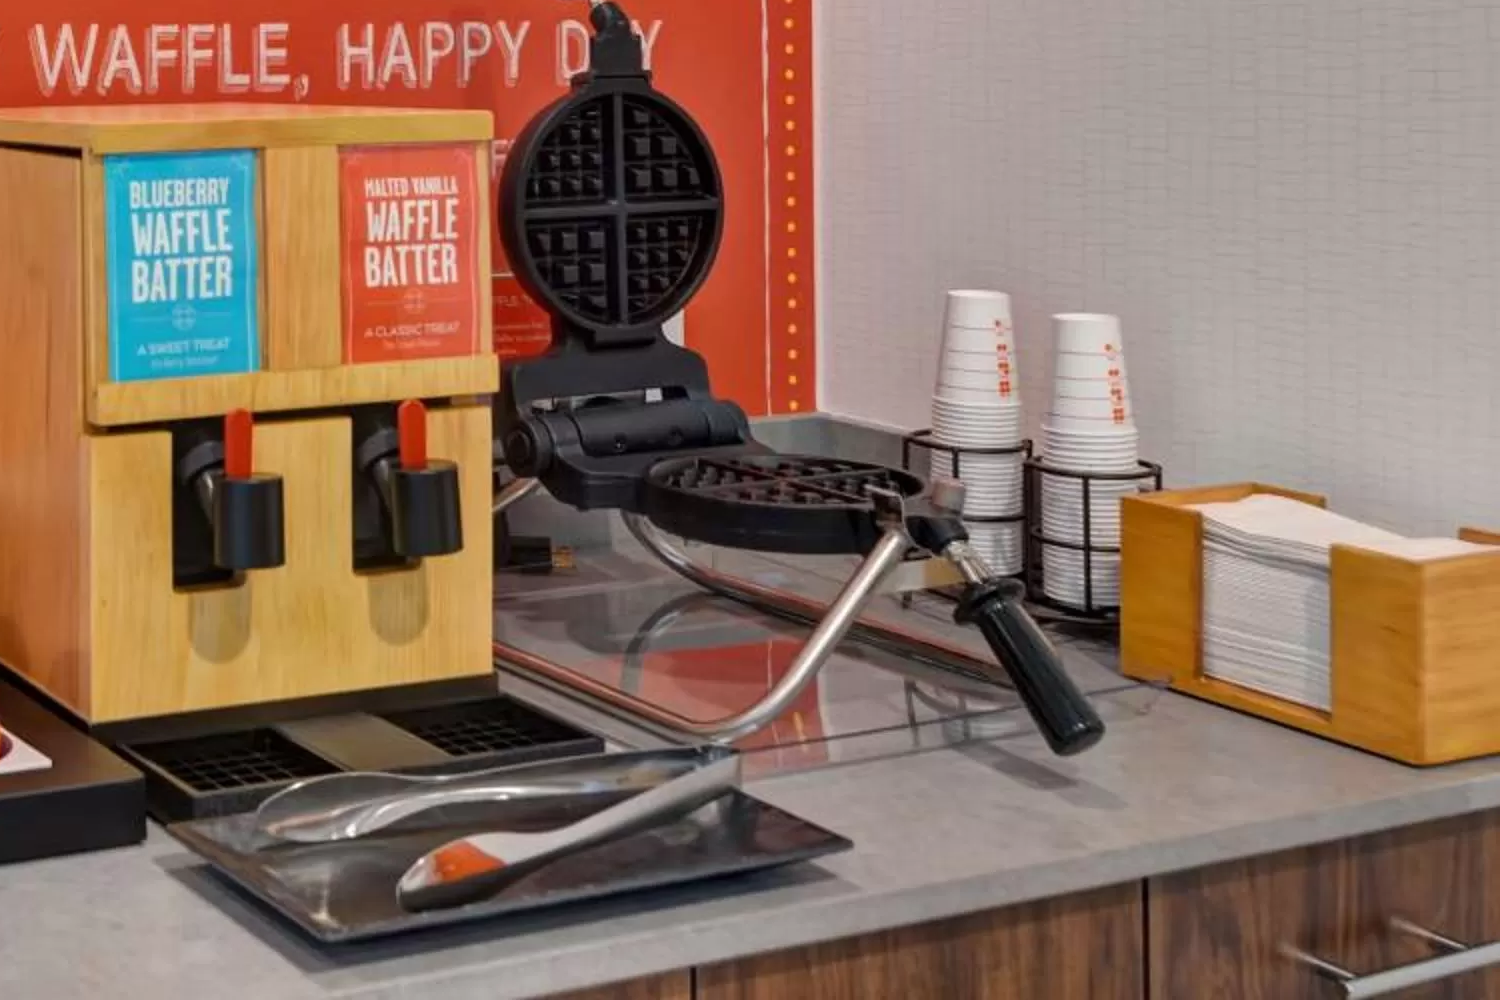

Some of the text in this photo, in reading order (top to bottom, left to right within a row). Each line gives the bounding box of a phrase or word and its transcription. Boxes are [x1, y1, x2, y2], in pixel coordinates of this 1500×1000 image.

[29, 22, 310, 100] WAFFLE,
[337, 20, 532, 94] HAPPY
[554, 18, 663, 87] DY
[129, 177, 231, 209] BLUEBERRY
[364, 175, 459, 198] MALTED VANILLA
[131, 207, 234, 256] WAFFLE
[366, 197, 459, 244] WAFFLE
[131, 254, 233, 304] BATTER
[364, 242, 459, 288] BATTER
